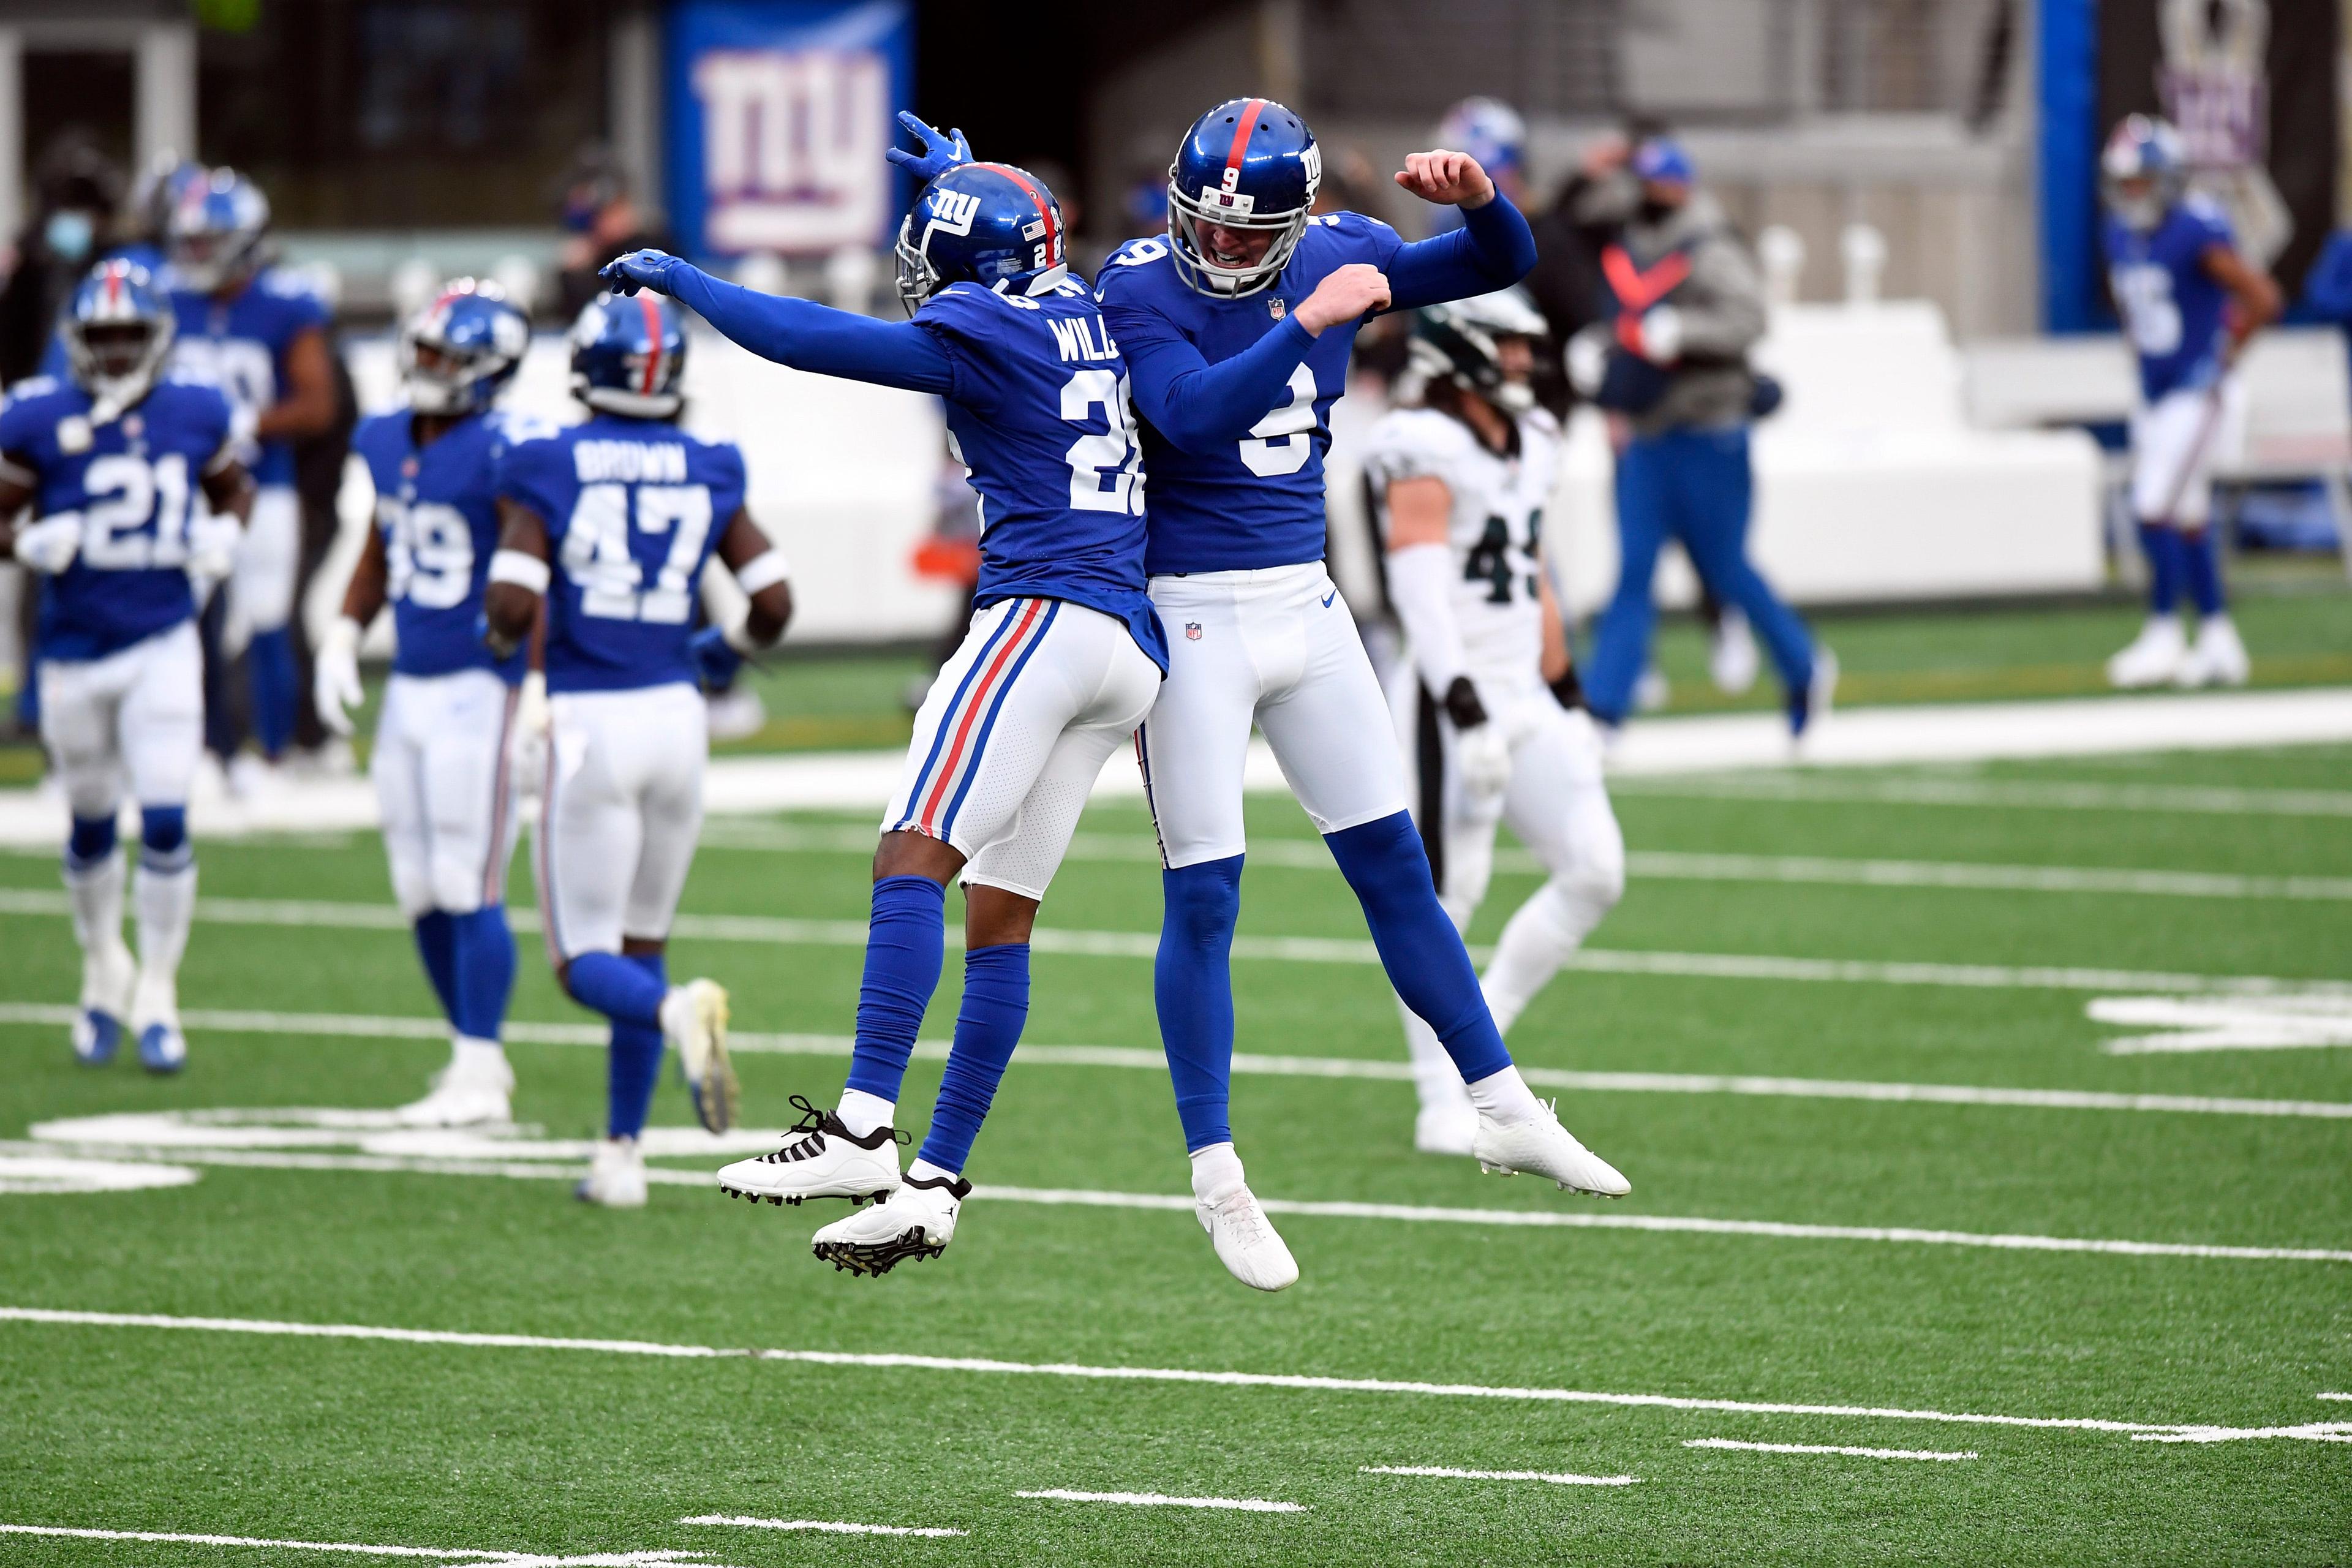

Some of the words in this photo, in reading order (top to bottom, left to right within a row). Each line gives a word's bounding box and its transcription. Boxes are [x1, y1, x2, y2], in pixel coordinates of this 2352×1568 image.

[1221, 167, 1240, 193] 9
[1033, 235, 1062, 268] 28
[1115, 240, 1168, 266] 9
[573, 439, 687, 483] BROWN
[81, 452, 190, 570] 21
[559, 483, 712, 625] 47
